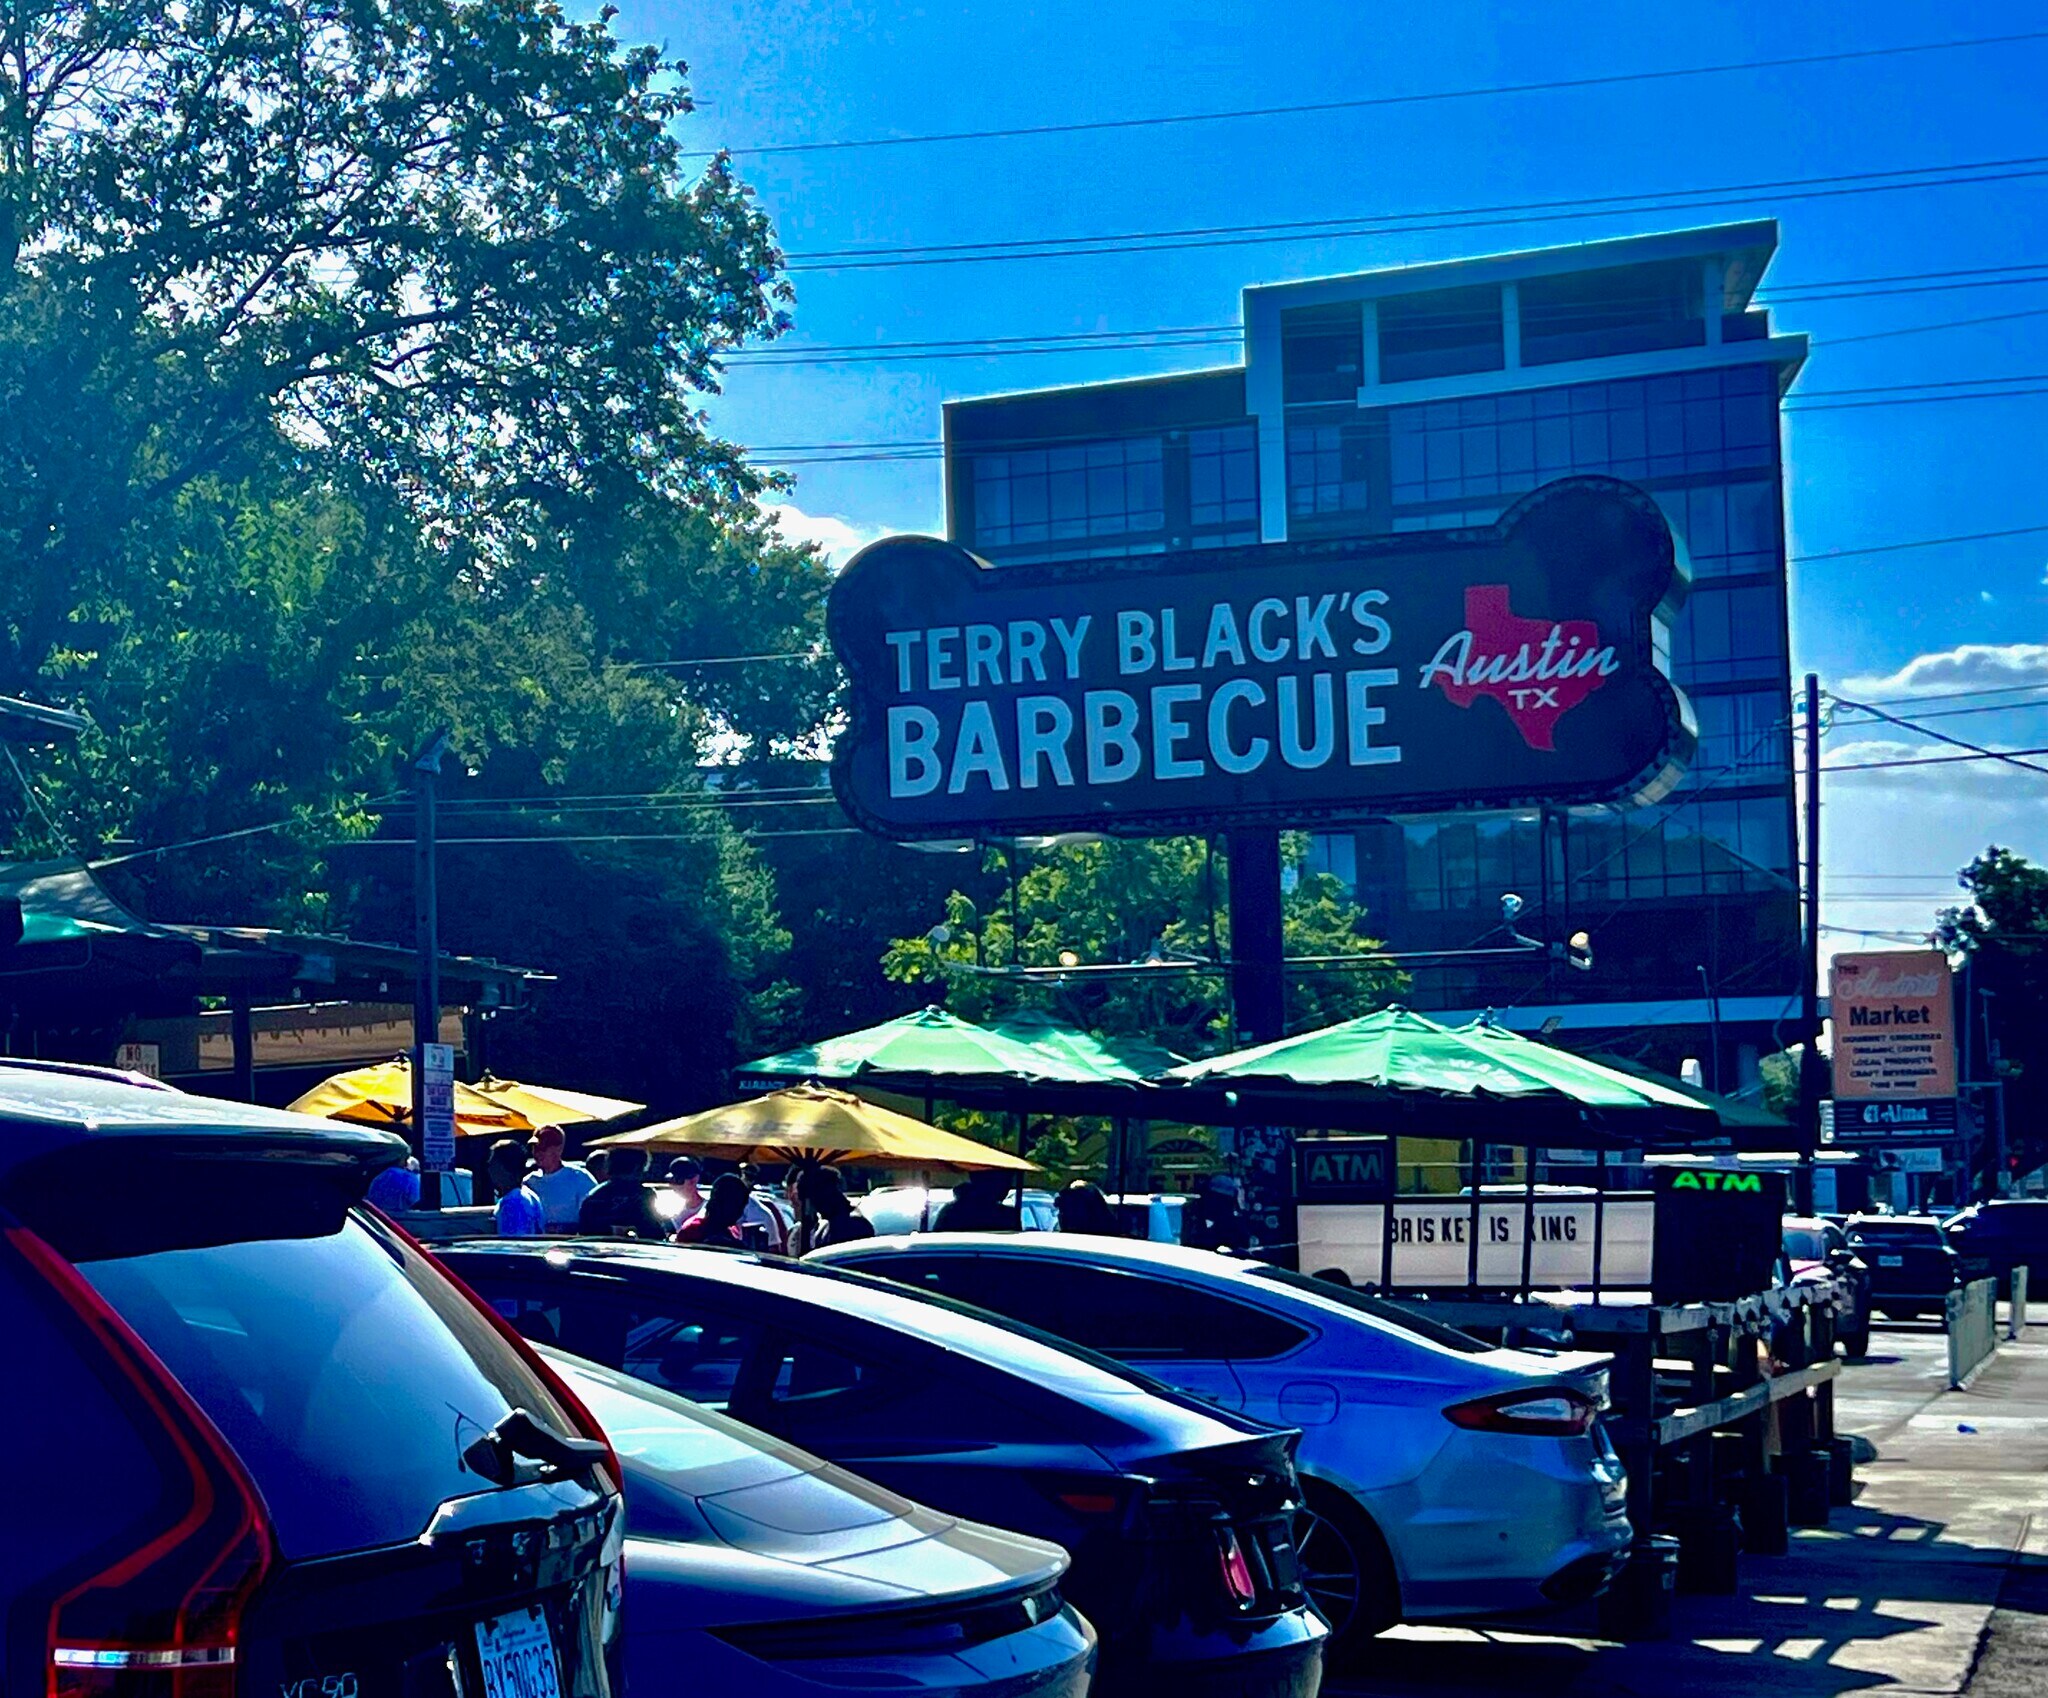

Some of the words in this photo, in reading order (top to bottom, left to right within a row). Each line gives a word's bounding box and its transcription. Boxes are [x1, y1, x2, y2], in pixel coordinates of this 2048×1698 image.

[885, 615, 1092, 693] TERRY
[1117, 589, 1392, 675] BLACK'S
[1419, 624, 1619, 689] Austin
[1508, 687, 1559, 710] TX
[887, 668, 1402, 798] BARBECUE
[1849, 1004, 1930, 1026] Market
[1311, 1154, 1381, 1182] ATM
[1672, 1171, 1762, 1193] ATM
[1391, 1217, 1472, 1243] BRISKE
[1490, 1216, 1509, 1242] IS
